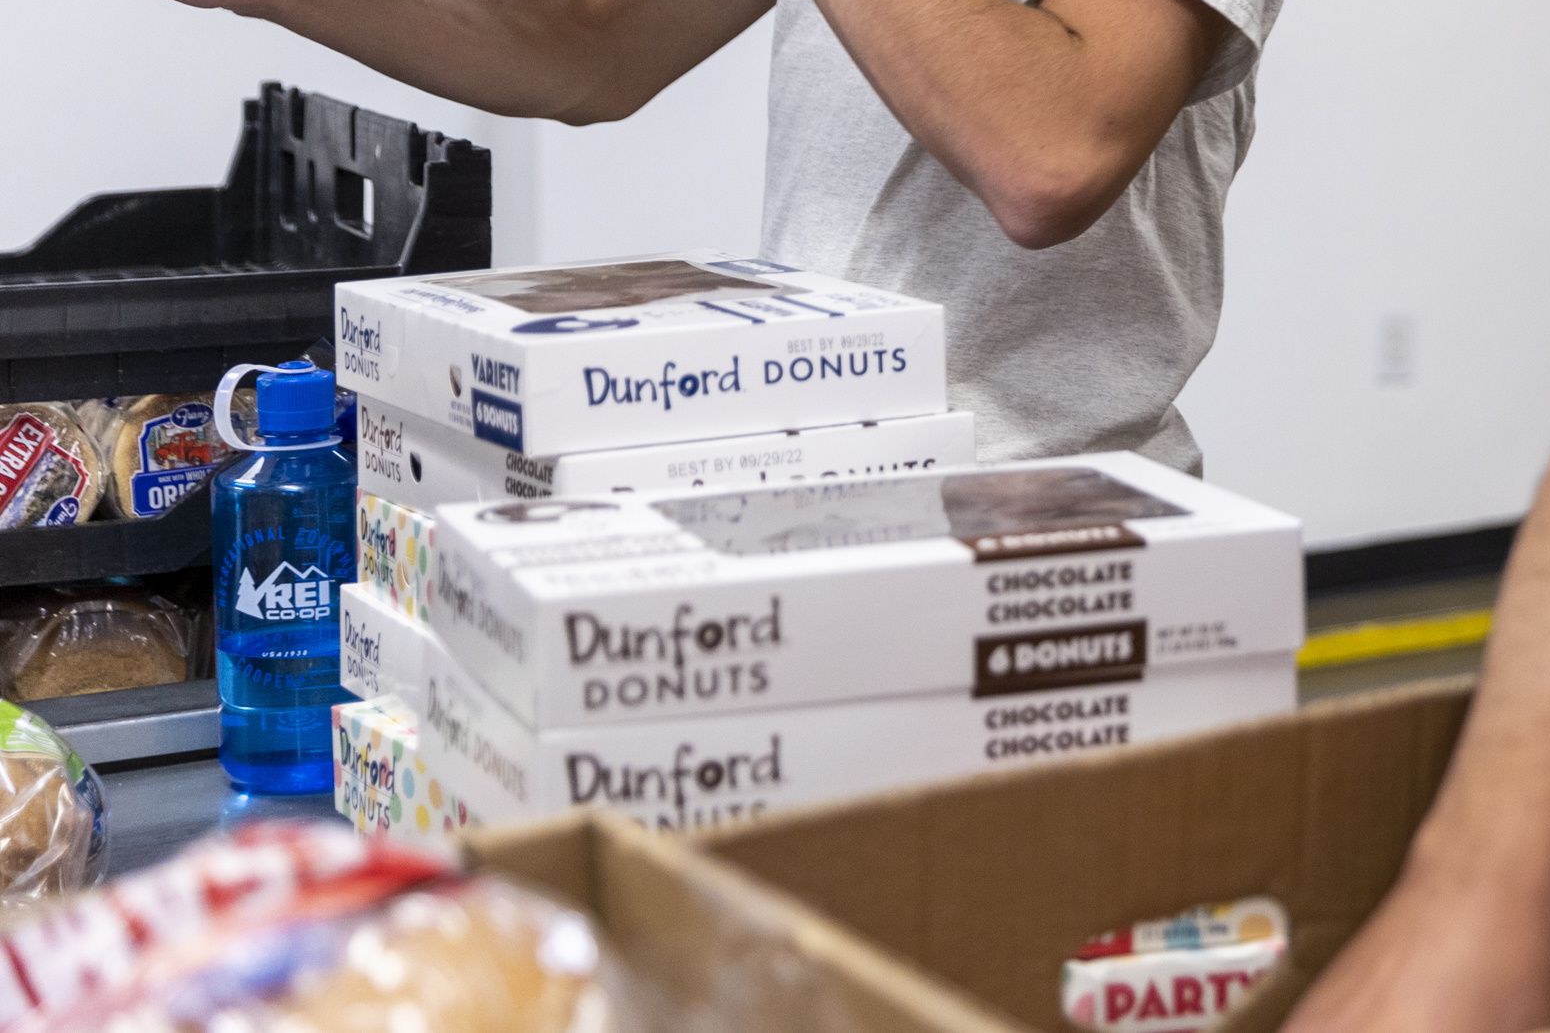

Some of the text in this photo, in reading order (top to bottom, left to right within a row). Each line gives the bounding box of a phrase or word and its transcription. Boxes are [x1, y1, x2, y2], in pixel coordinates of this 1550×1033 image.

[340, 306, 381, 354] Dunford
[787, 338, 813, 354] BEST
[819, 337, 833, 351] BY
[344, 351, 380, 382] DONUTS
[471, 353, 520, 395] VARIETY
[583, 347, 907, 410] Dunford DONUTS
[361, 405, 403, 455] Dunford
[476, 401, 483, 422] 6
[483, 404, 518, 436] DONUTS
[365, 450, 402, 483] DONUTS
[667, 459, 708, 478] BEST
[714, 455, 733, 472] BY
[739, 448, 803, 469] 09/29/22
[360, 507, 396, 559] Dunford
[363, 554, 395, 588] DONUTS
[986, 560, 1133, 595] CHOCOLATE
[265, 579, 331, 609] REI
[986, 589, 1133, 625] CHOCOLATE
[344, 609, 381, 666] Dunford
[564, 594, 782, 668] Dunford
[987, 644, 1010, 675] 6
[1012, 631, 1134, 673] DONUTS
[346, 656, 379, 694] DONUTS
[582, 661, 770, 712] DONUTS
[984, 693, 1130, 731] CHOCOLATE
[338, 726, 395, 795] Dunford
[984, 723, 1130, 761] CHOCOLATE
[565, 733, 782, 808] Dunford
[343, 780, 392, 831] DONUTS
